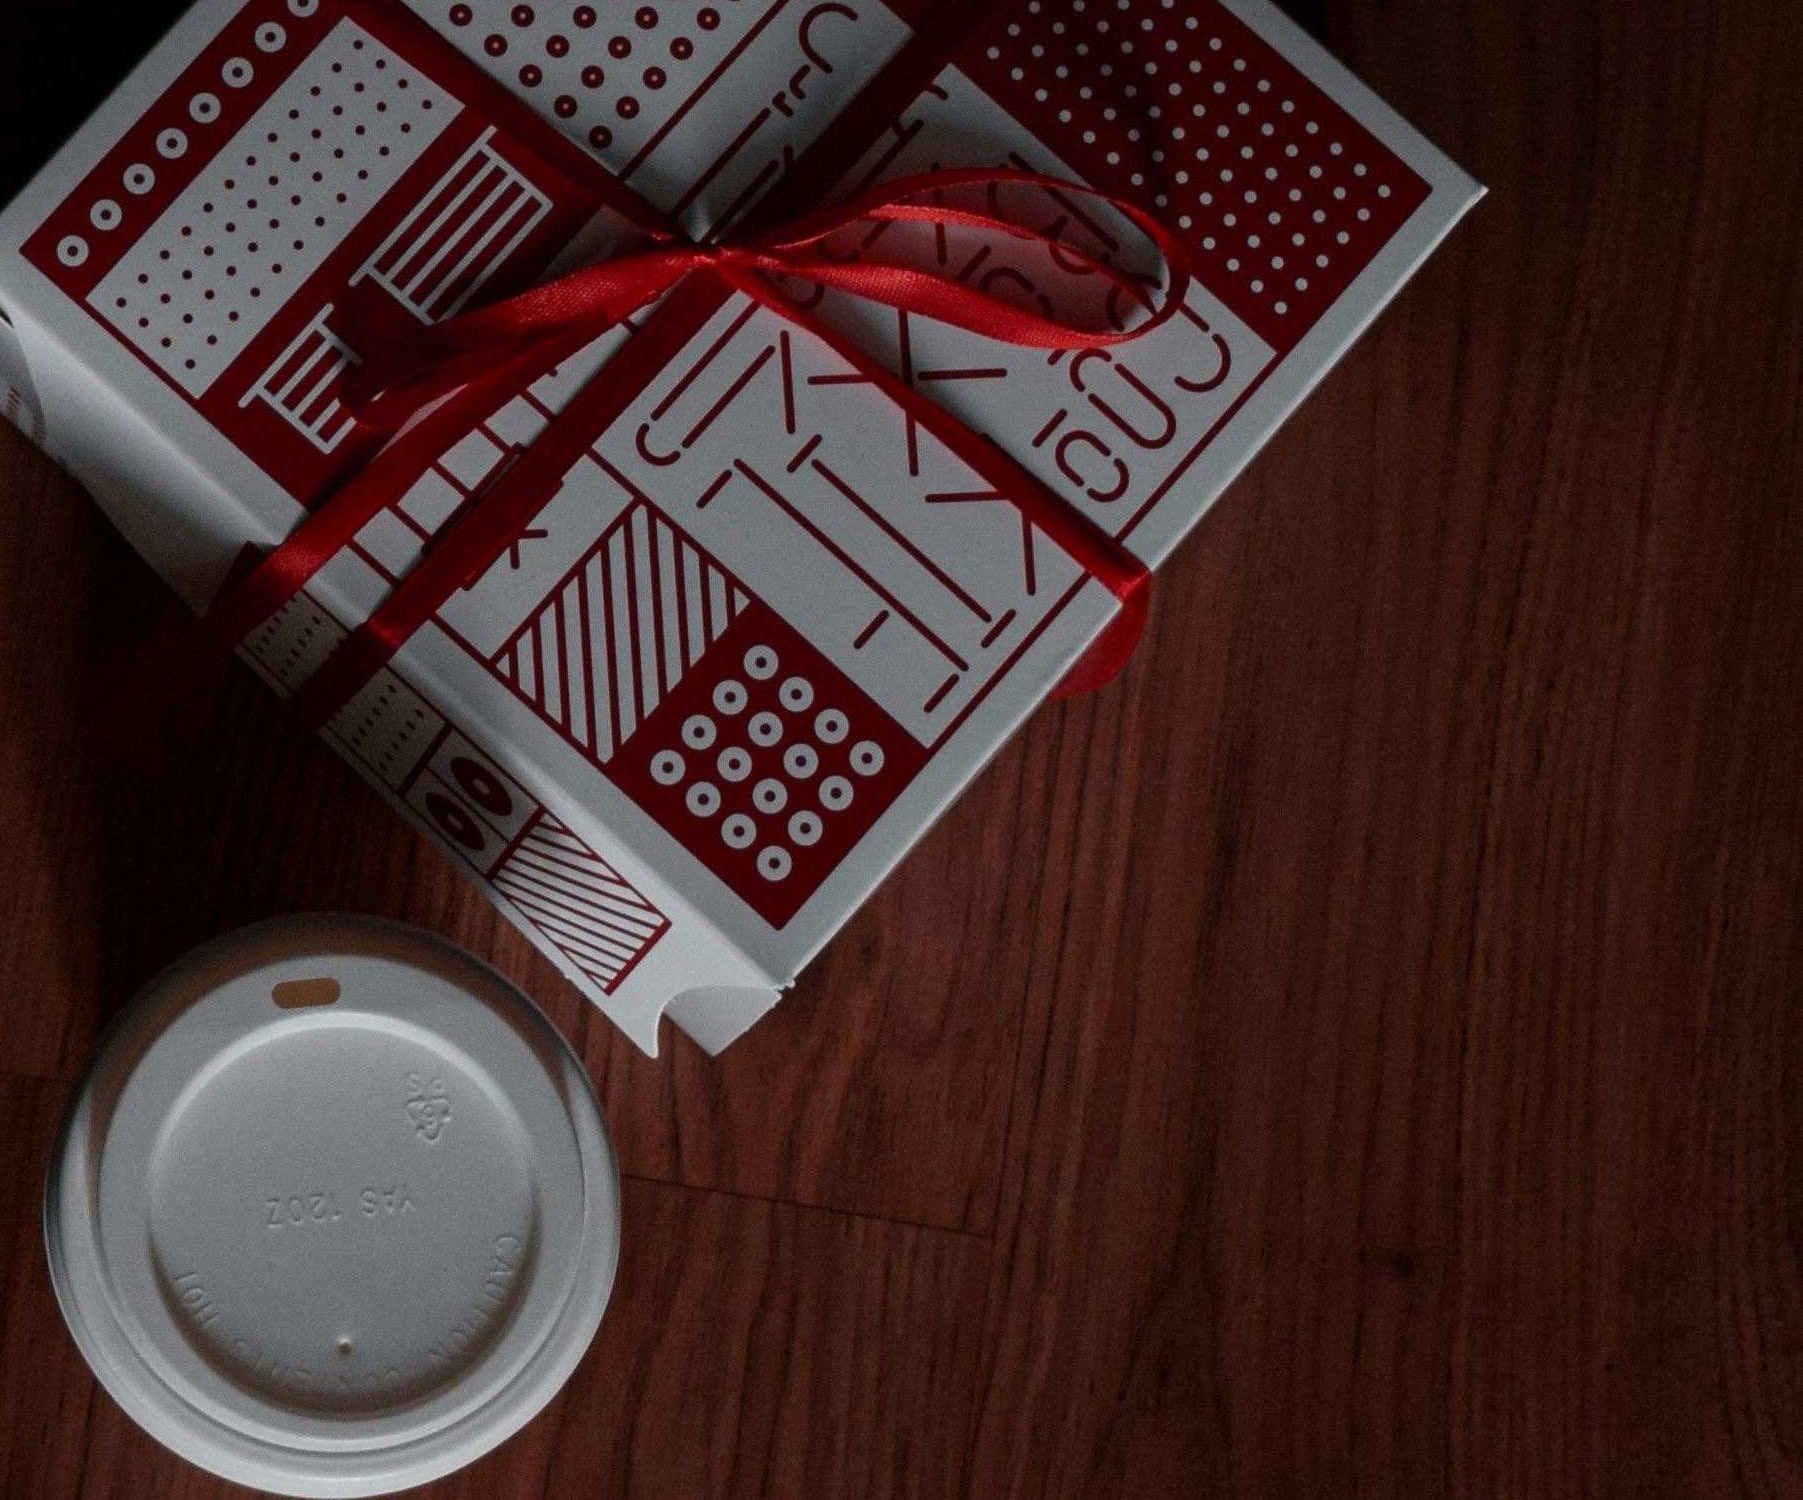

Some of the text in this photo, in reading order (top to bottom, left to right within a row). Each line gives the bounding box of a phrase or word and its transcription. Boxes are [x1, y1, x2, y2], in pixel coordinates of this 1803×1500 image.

[359, 1183, 417, 1219] YAS
[173, 1271, 220, 1330] HOT
[427, 1234, 523, 1371] CAUTION
